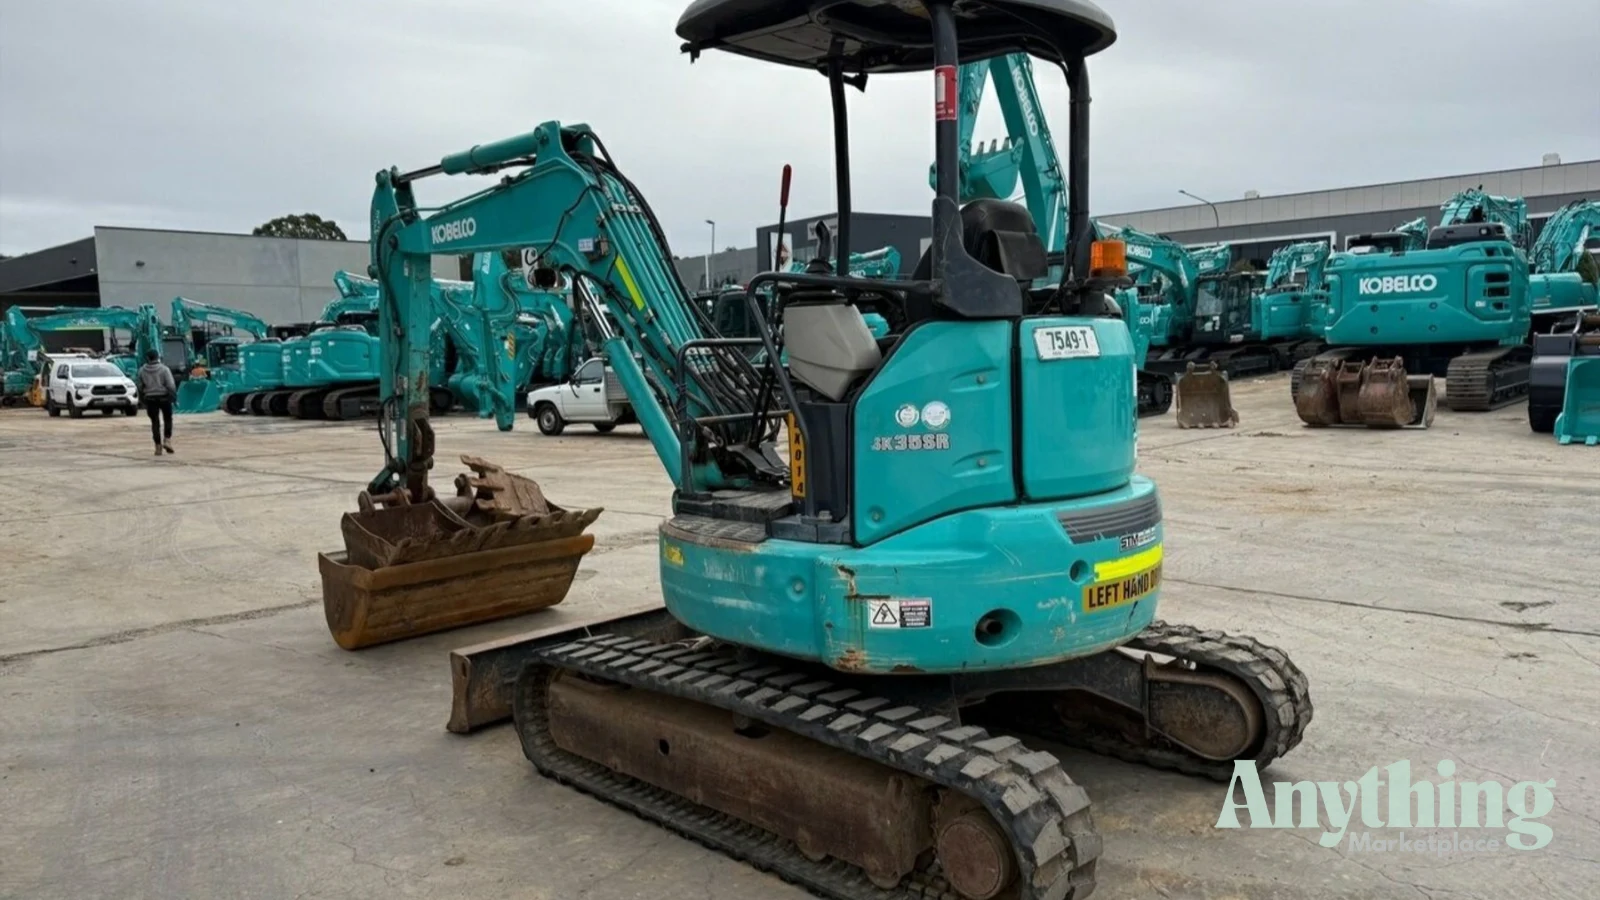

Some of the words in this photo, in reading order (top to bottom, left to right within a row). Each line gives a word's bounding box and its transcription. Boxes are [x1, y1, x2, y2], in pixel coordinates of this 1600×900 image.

[1012, 65, 1039, 136] KOBELCO
[431, 216, 477, 245] KOBELCO
[1359, 273, 1438, 295] KOBELCO
[1088, 582, 1120, 609] LEFT
[1123, 571, 1149, 600] HAND
